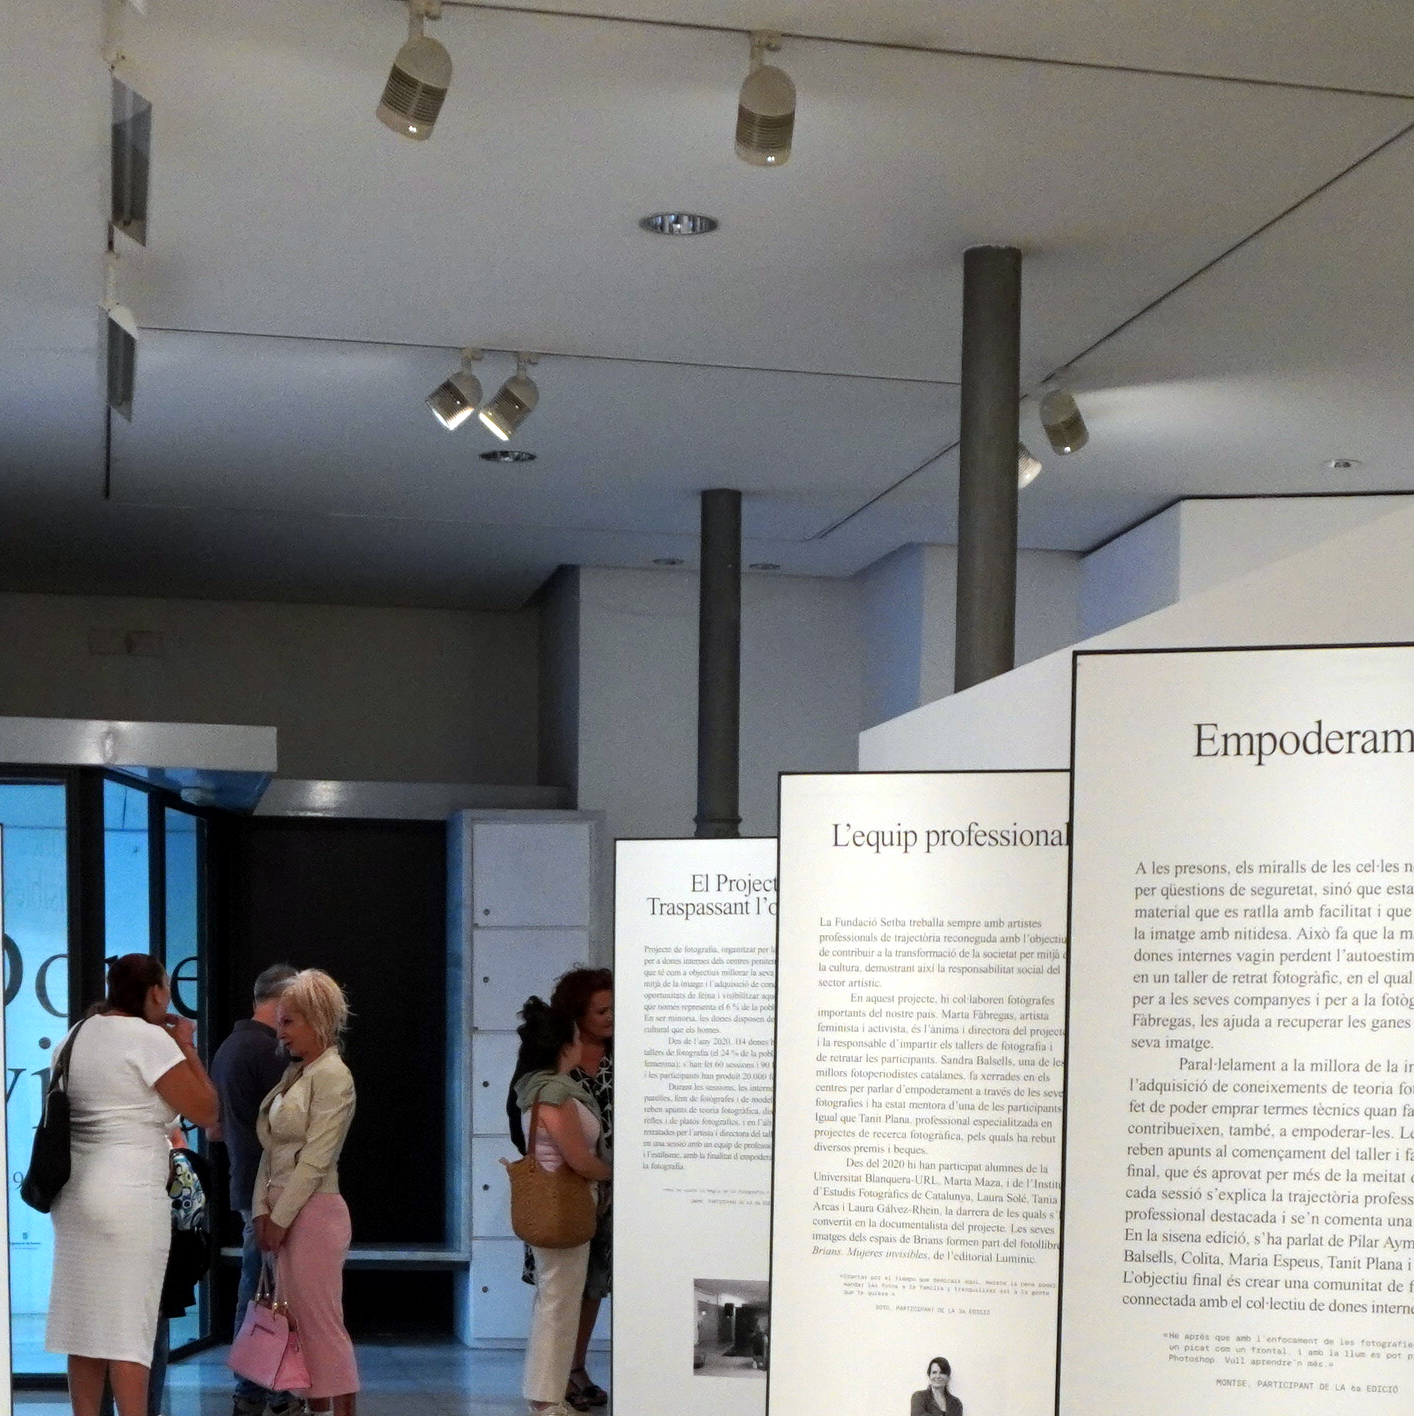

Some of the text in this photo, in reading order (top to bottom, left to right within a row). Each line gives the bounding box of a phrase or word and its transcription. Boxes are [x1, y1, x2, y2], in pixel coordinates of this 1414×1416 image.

[924, 821, 1070, 854] professional
[1135, 861, 1147, 875] A
[1151, 860, 1170, 875] les
[1174, 864, 1230, 878] presons,
[1235, 860, 1254, 874] els
[1258, 859, 1306, 874] miralls
[1310, 859, 1328, 874] de
[1332, 859, 1351, 873] les
[647, 897, 749, 920] Traspassant
[819, 916, 1042, 930] La Fundació Setba treballa sempre amb artistes
[846, 1157, 1048, 1174] Des del 2020 hi han participat alumnes de la
